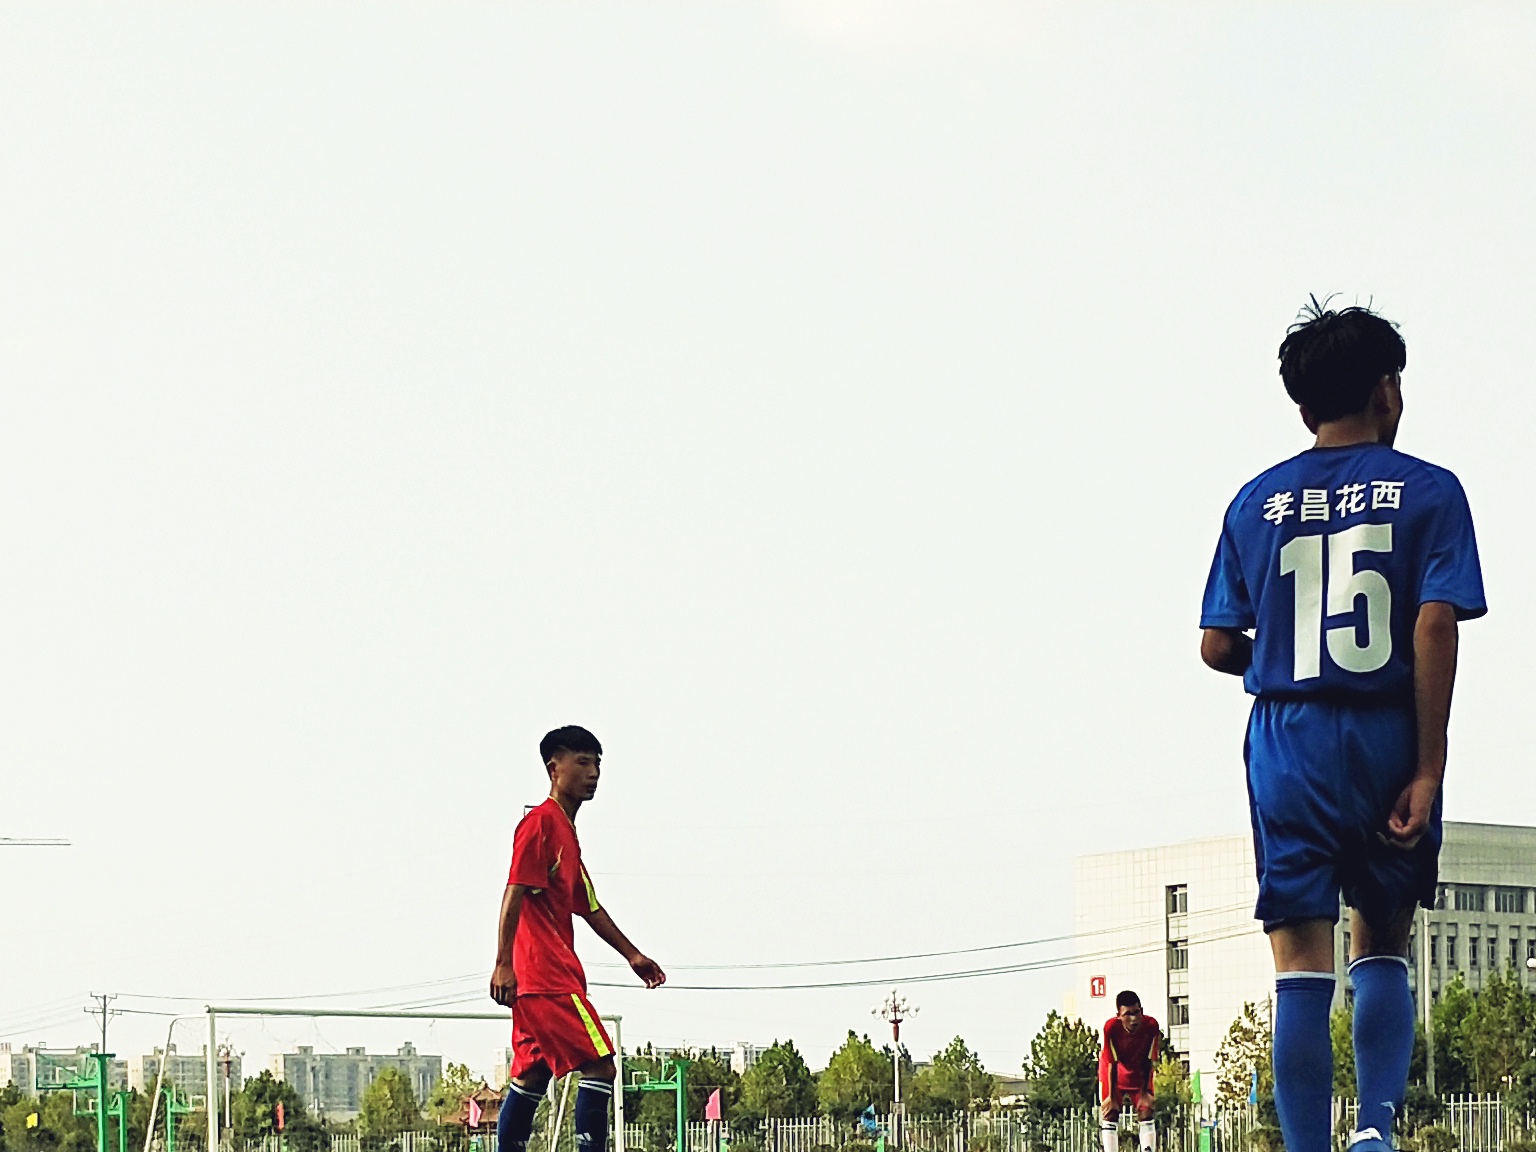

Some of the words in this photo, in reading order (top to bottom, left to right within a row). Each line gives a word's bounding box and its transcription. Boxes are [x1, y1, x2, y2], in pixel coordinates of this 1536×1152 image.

[1263, 480, 1405, 526] 孝昌花西
[1279, 522, 1393, 682] 15
